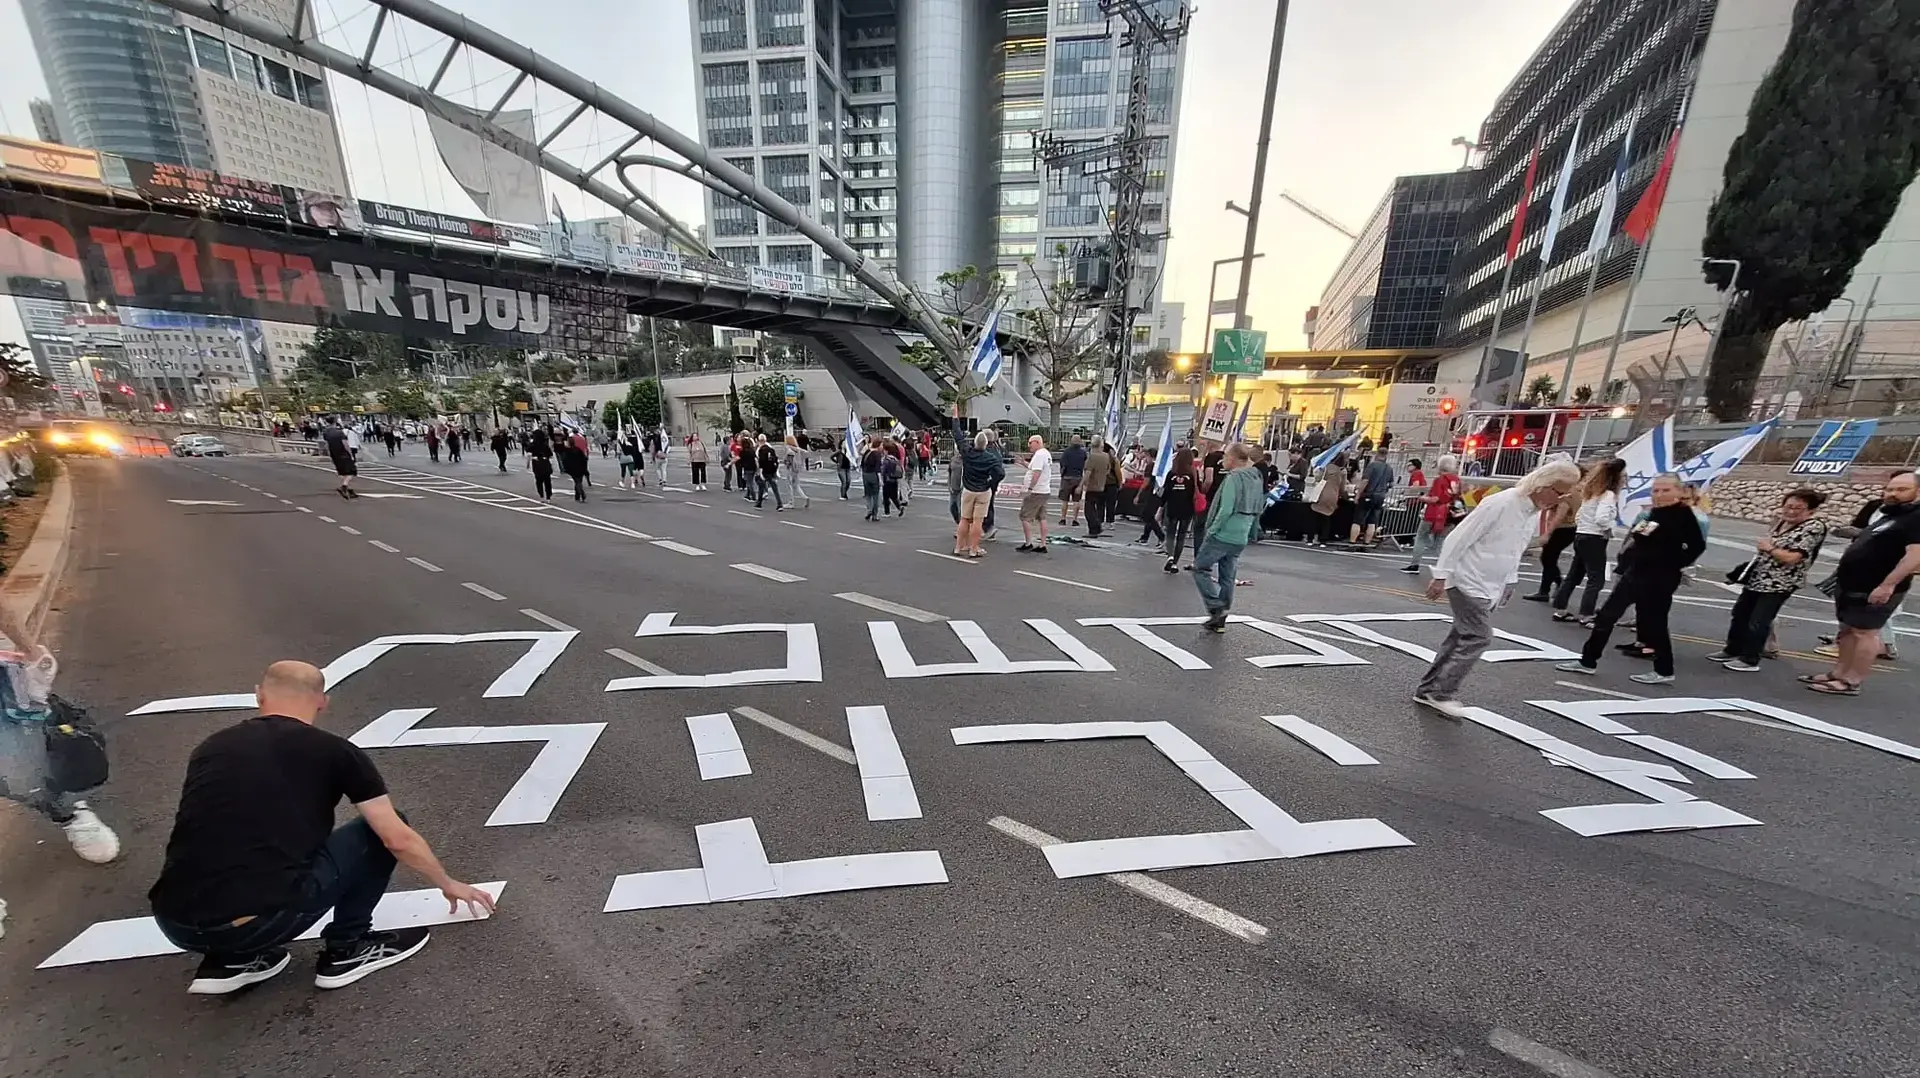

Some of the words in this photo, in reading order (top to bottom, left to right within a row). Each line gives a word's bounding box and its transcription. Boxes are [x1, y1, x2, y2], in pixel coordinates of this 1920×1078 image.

[225, 198, 252, 211] לירי
[374, 203, 406, 226] Bring
[406, 208, 437, 228] Them
[438, 215, 468, 234] Home
[642, 248, 665, 260] שכולם
[666, 252, 676, 261] עד
[89, 225, 204, 298] דין
[660, 261, 678, 272] כולנו
[211, 243, 329, 308] גזר
[794, 274, 802, 282] עד
[331, 260, 403, 318] או
[408, 273, 550, 335] עסקה
[1214, 402, 1228, 411] לא
[1205, 418, 1225, 430] את
